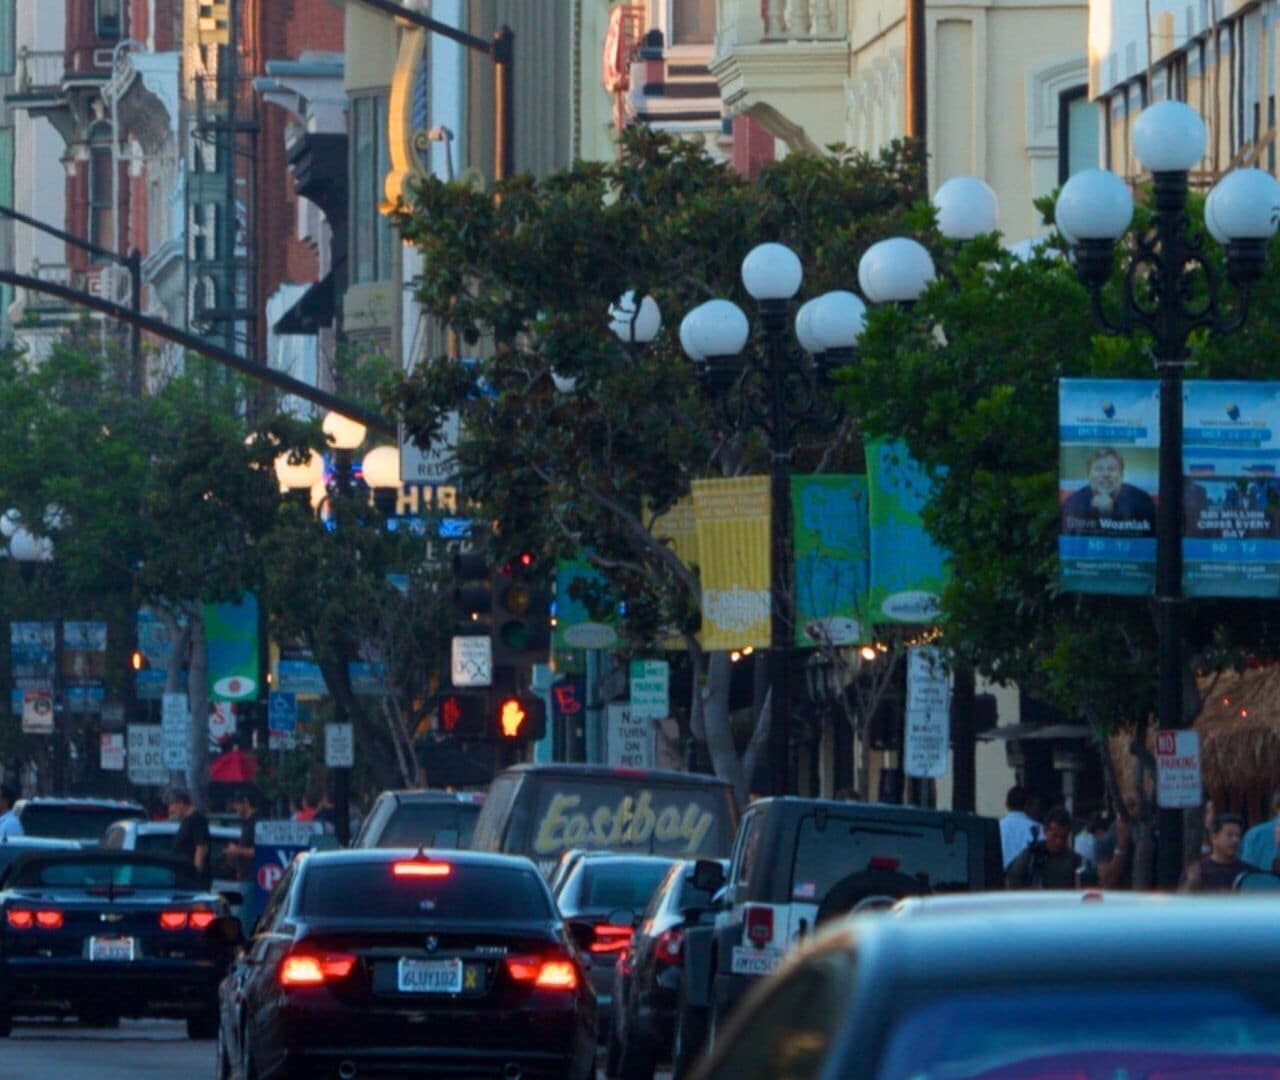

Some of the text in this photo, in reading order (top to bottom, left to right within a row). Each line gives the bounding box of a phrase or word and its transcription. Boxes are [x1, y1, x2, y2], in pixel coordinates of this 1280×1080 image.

[1099, 517, 1152, 532] Wozniak
[619, 727, 647, 738] TURN
[624, 742, 641, 752] ON
[621, 755, 643, 768] RED
[534, 790, 713, 855] Eastbay
